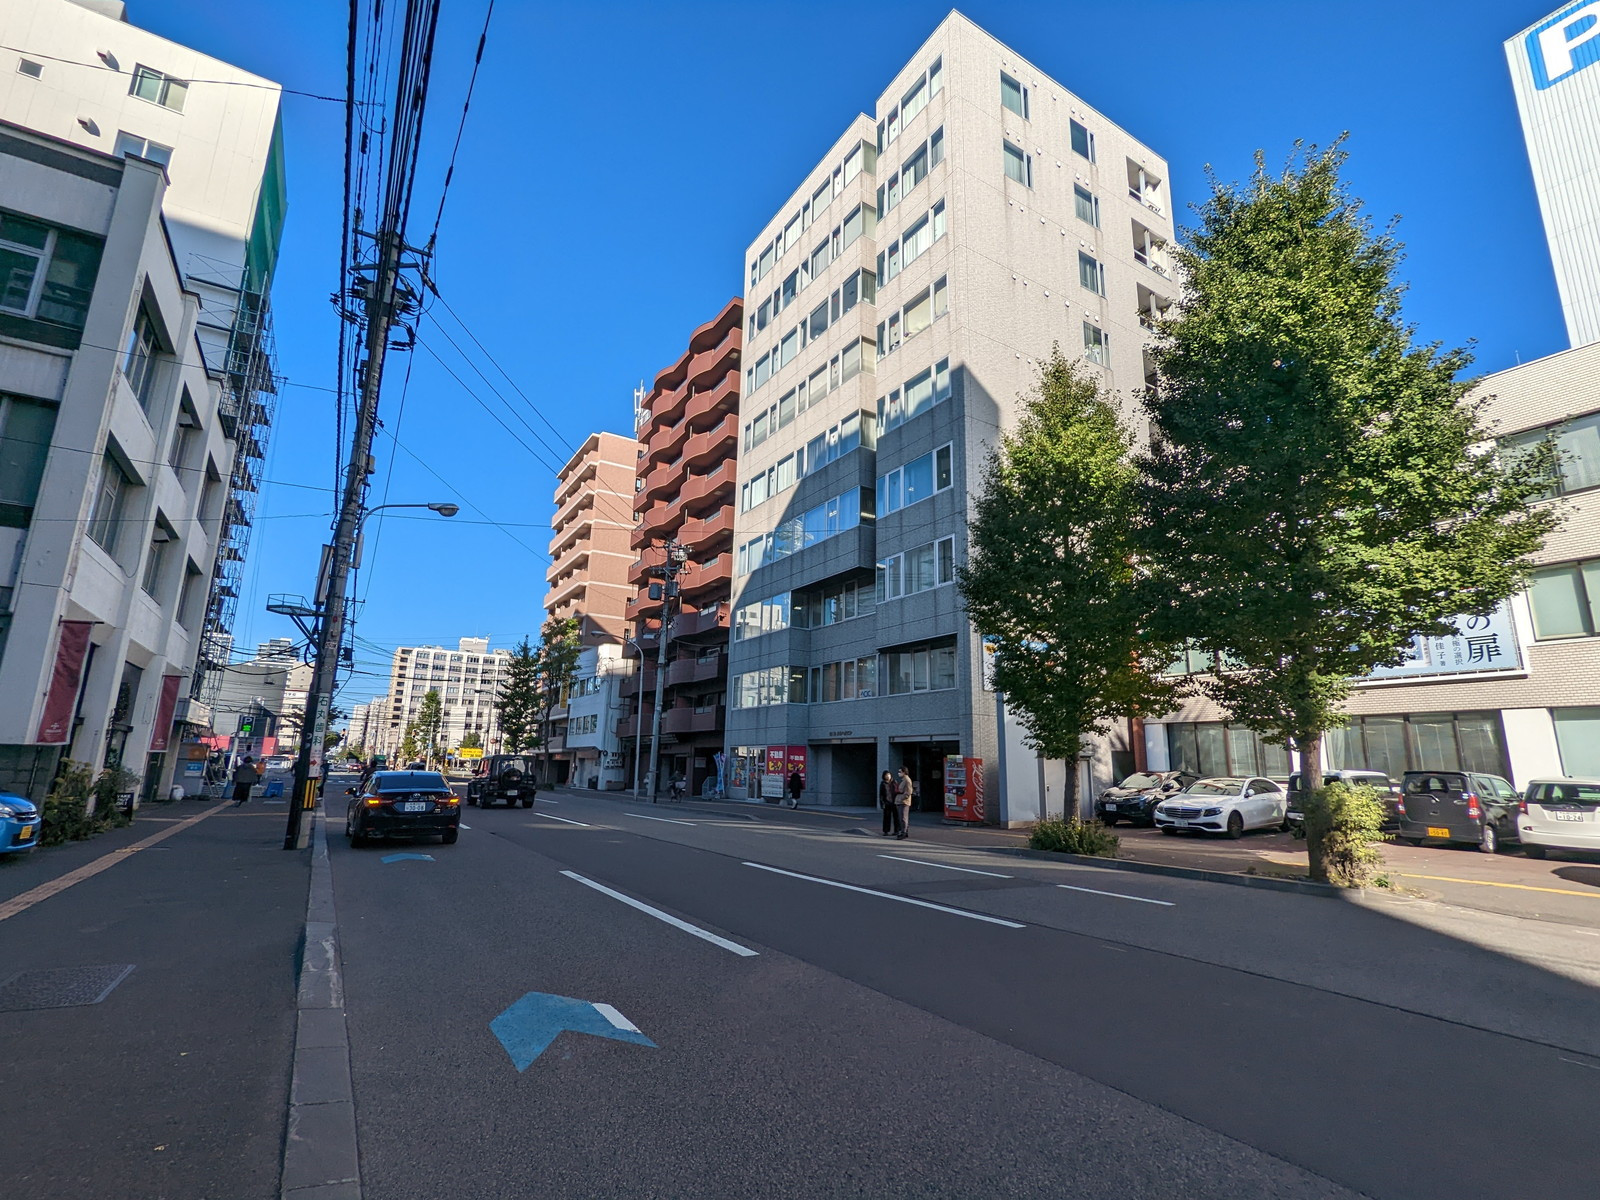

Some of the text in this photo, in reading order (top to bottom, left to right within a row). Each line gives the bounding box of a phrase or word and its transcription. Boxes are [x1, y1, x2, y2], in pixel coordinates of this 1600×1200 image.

[1538, 1, 1600, 82] P
[1465, 615, 1502, 663] の扉
[312, 695, 329, 746] 石丸歯科
[972, 760, 984, 819] Coca-Cola
